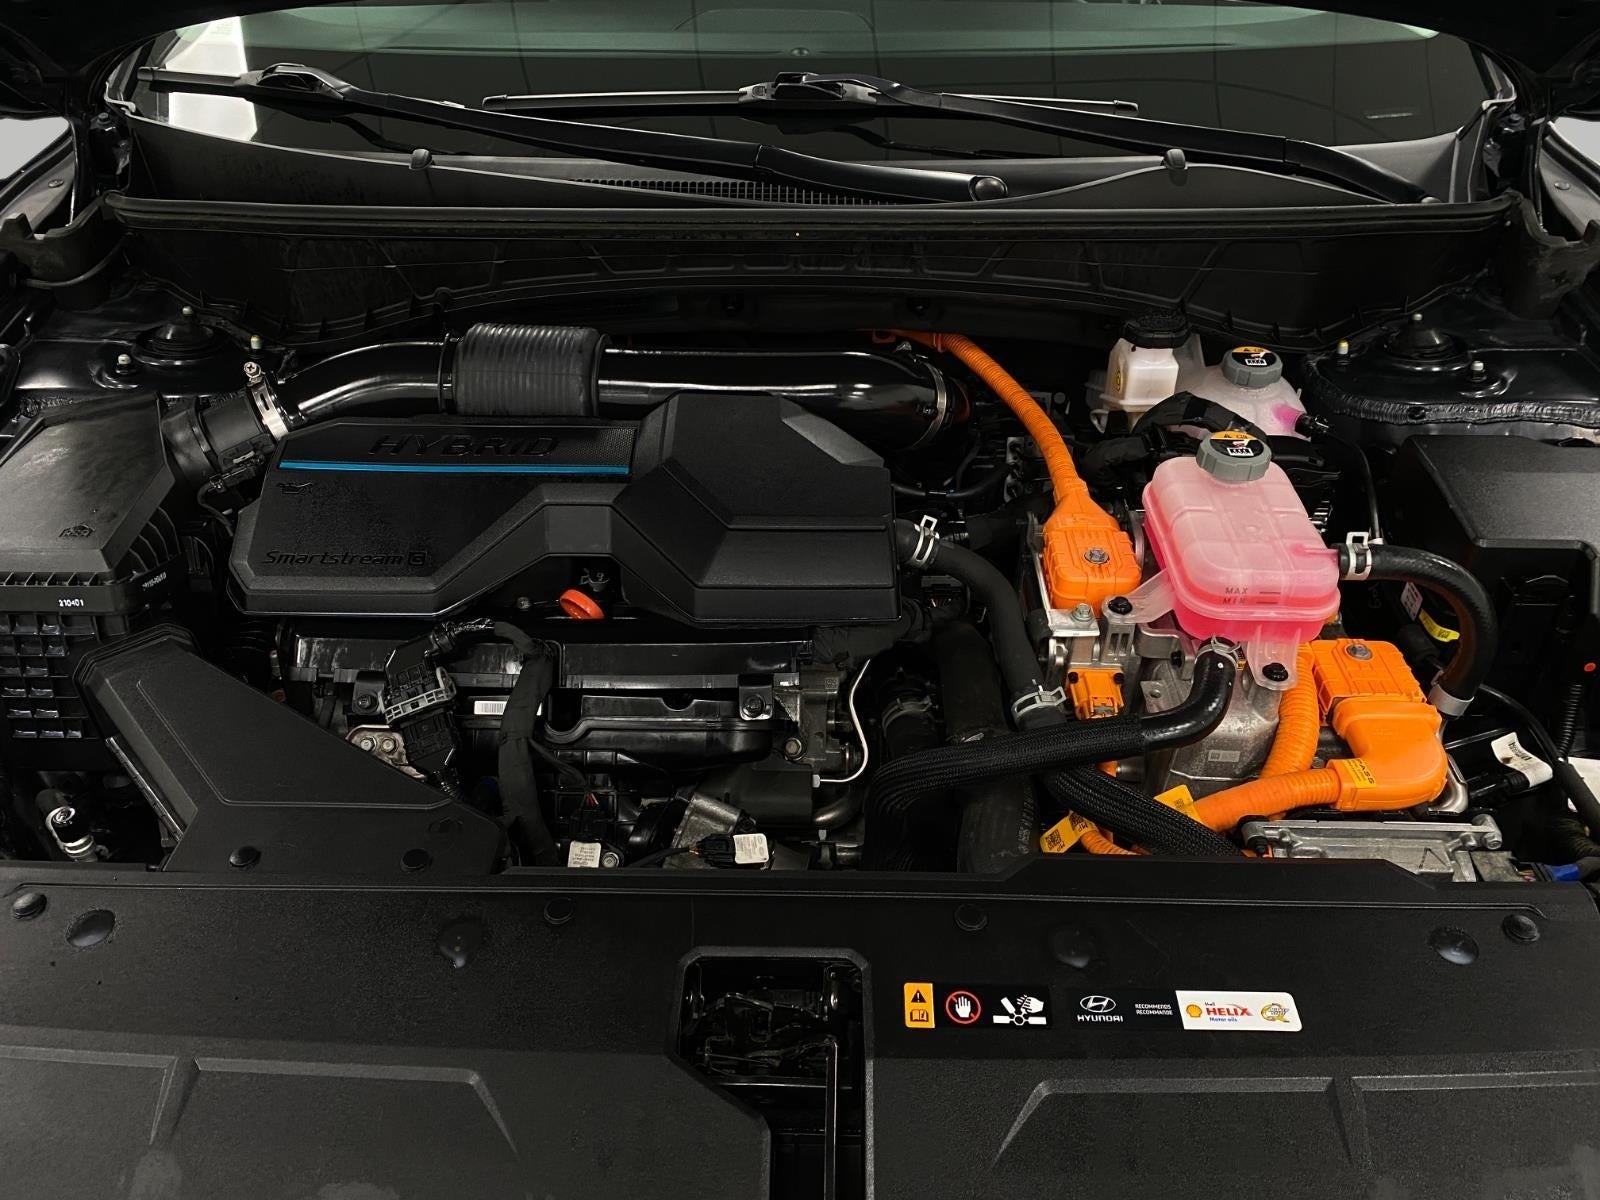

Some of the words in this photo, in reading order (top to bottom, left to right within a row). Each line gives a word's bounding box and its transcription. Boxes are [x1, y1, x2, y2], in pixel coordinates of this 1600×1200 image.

[367, 433, 560, 456] HYBRID
[262, 551, 404, 565] Smartstream
[58, 598, 84, 607] 210401
[1223, 597, 1246, 605] MIN
[1205, 1007, 1250, 1016] HELIX
[1076, 1014, 1124, 1023] HYUNDAI
